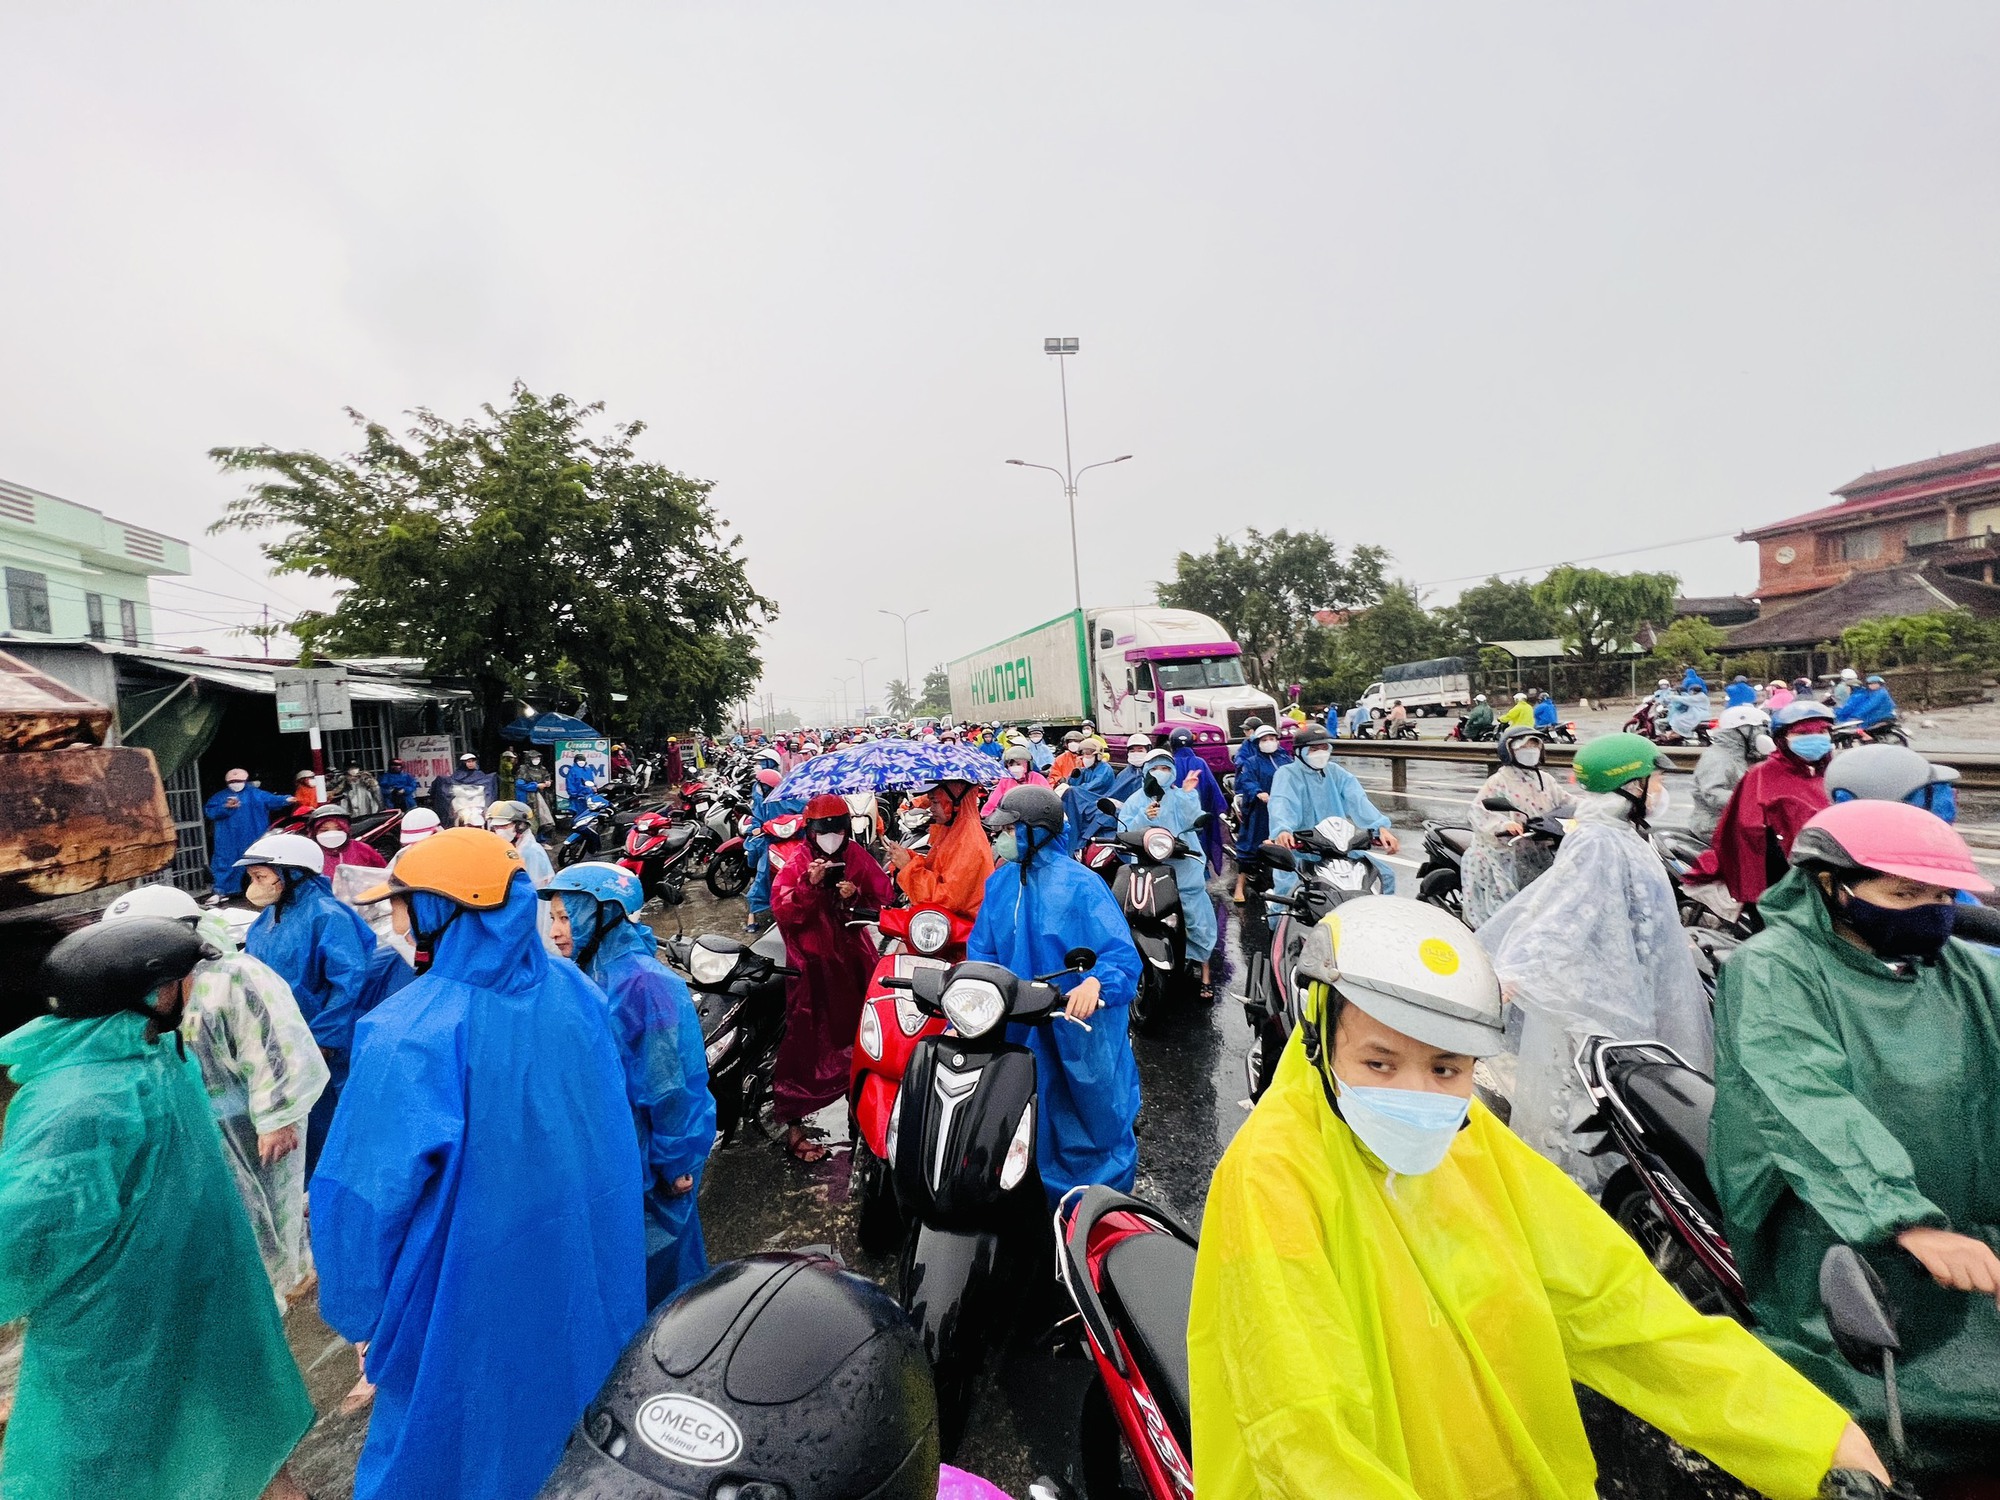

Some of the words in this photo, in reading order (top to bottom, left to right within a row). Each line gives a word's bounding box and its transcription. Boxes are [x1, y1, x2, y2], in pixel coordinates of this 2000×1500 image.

[970, 655, 1034, 706] HYUNDAI
[1651, 1170, 1734, 1260] SIRIU
[649, 1405, 725, 1449] OMEGA
[660, 1431, 698, 1453] Helmet
